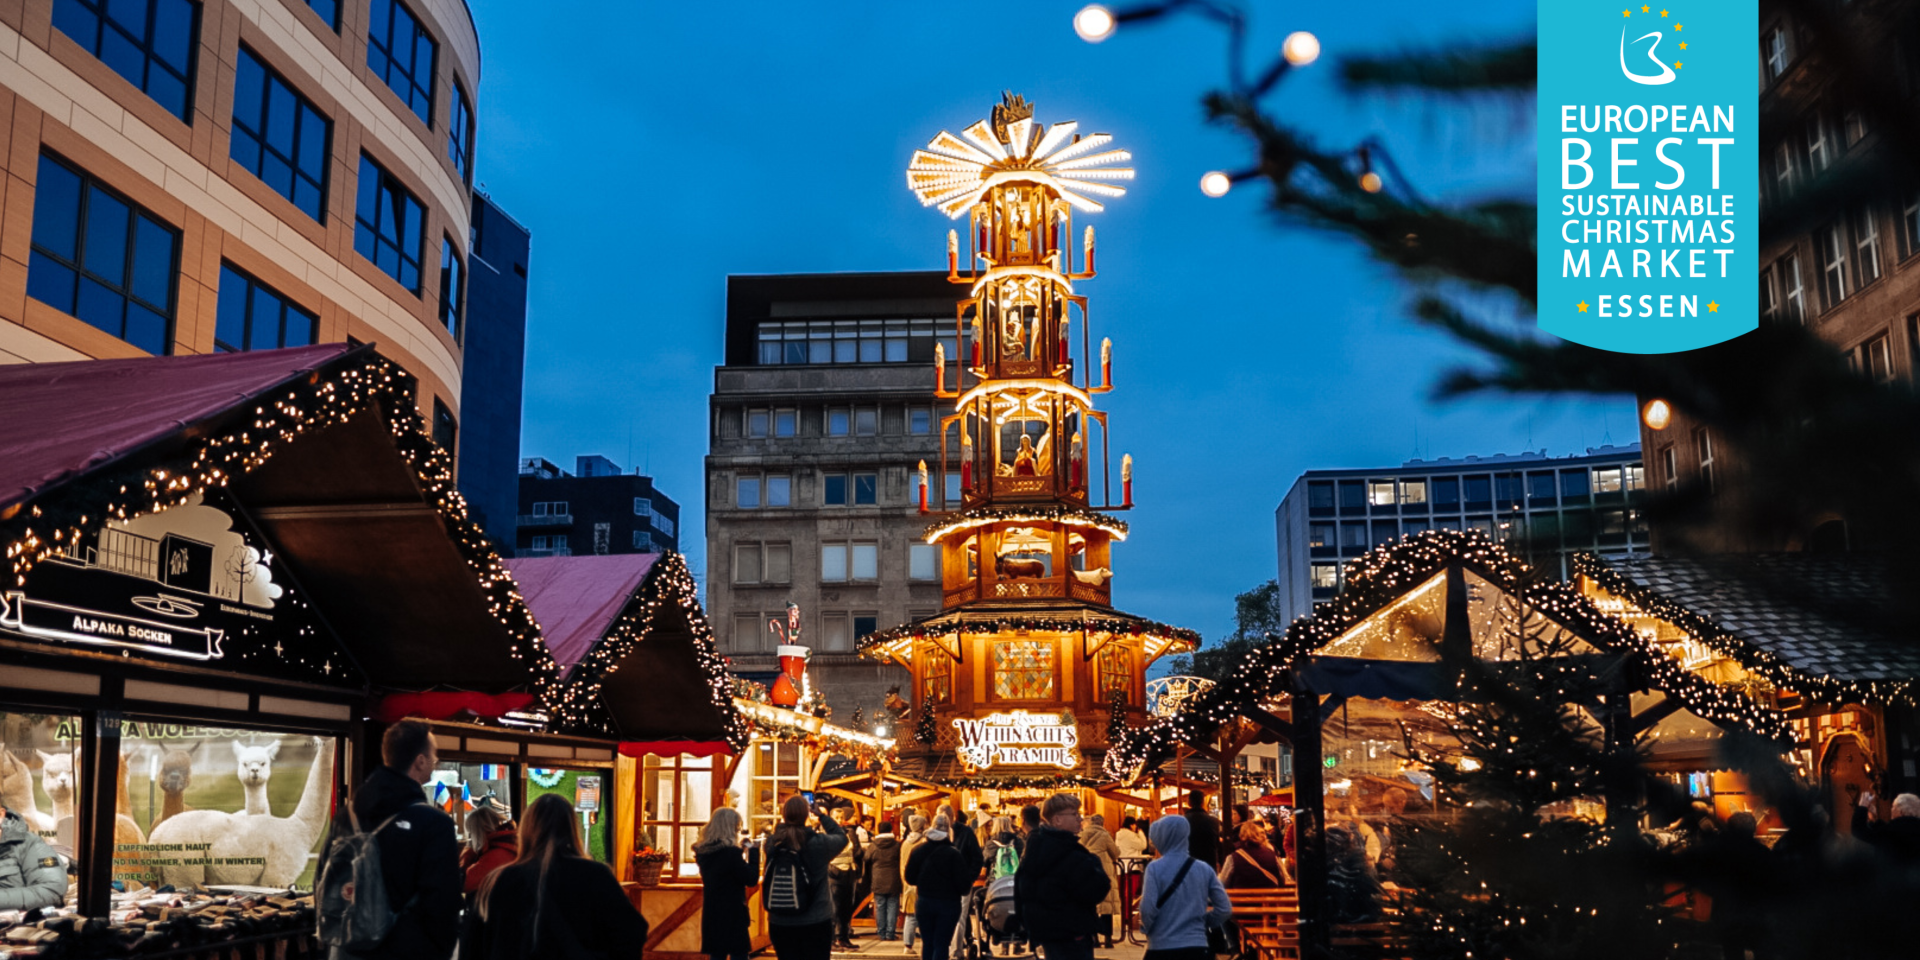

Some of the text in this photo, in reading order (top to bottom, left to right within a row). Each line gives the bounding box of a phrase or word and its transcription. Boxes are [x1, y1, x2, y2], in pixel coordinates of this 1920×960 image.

[73, 615, 172, 644] ALPAKA SOCKEN
[954, 719, 1076, 748] WEIHNACHTS
[981, 743, 1075, 767] PYRAMIDE
[117, 843, 212, 851] EMPFINDLICHE HAUT
[141, 858, 182, 867] SOMMER,
[184, 858, 212, 866] WARM
[226, 857, 265, 866] WINTER)
